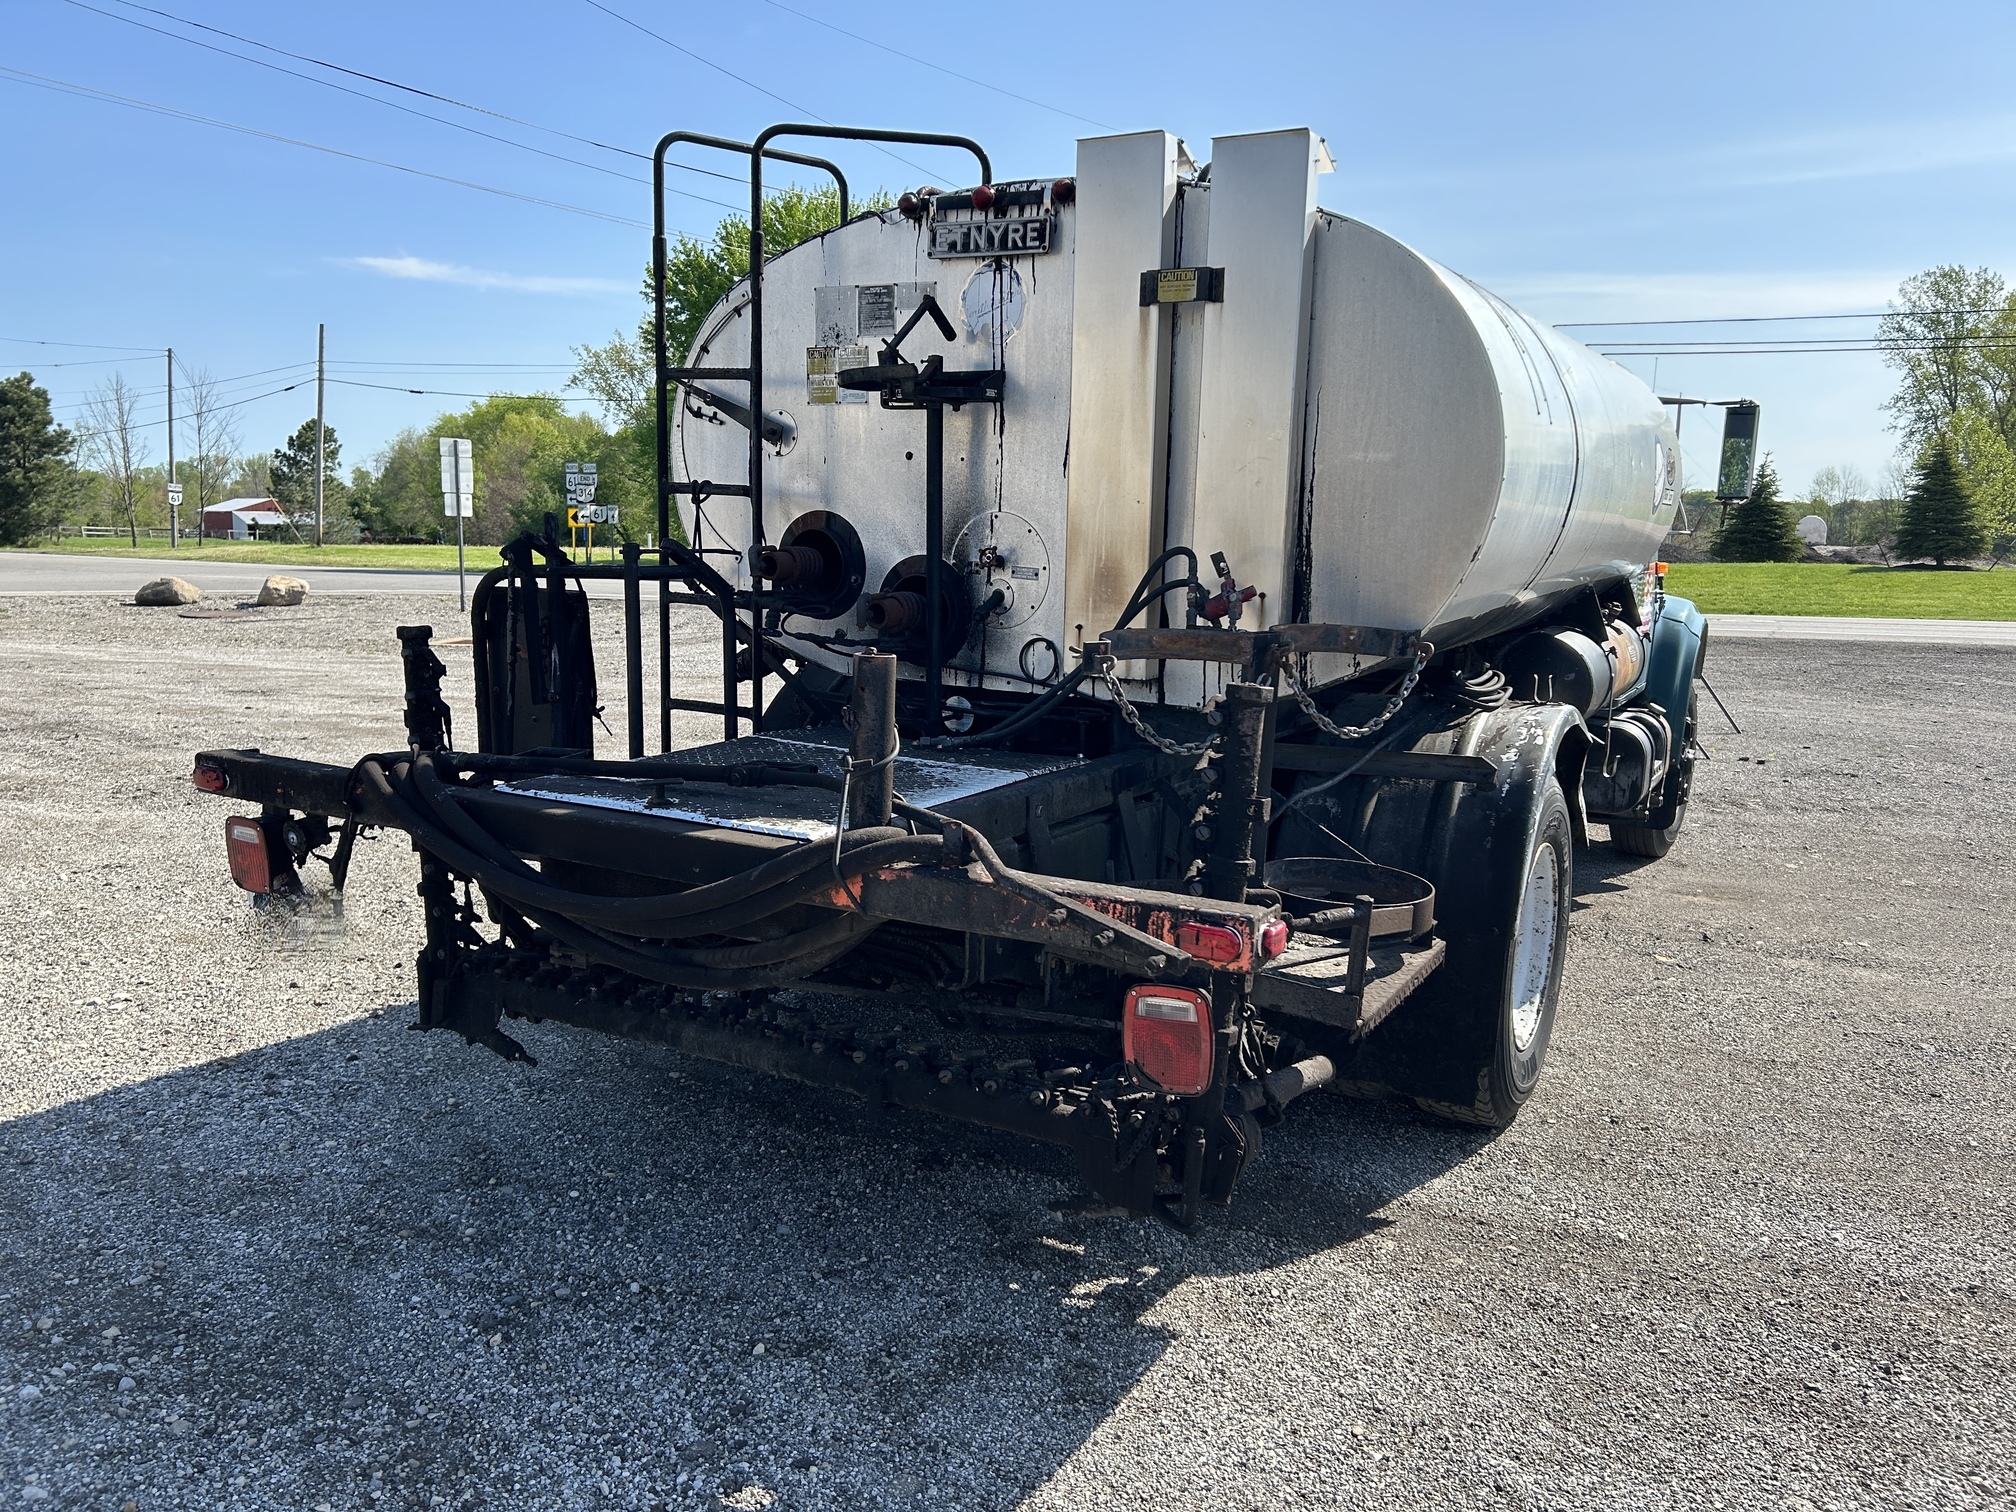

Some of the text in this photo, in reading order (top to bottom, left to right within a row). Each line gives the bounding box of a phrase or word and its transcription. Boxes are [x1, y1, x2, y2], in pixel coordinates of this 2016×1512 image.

[936, 222, 1040, 251] ETNYRE
[1161, 270, 1195, 282] CAUTION
[810, 350, 835, 358] CAUTON
[568, 477, 577, 486] 61
[578, 488, 593, 498] 314
[594, 509, 603, 519] 61
